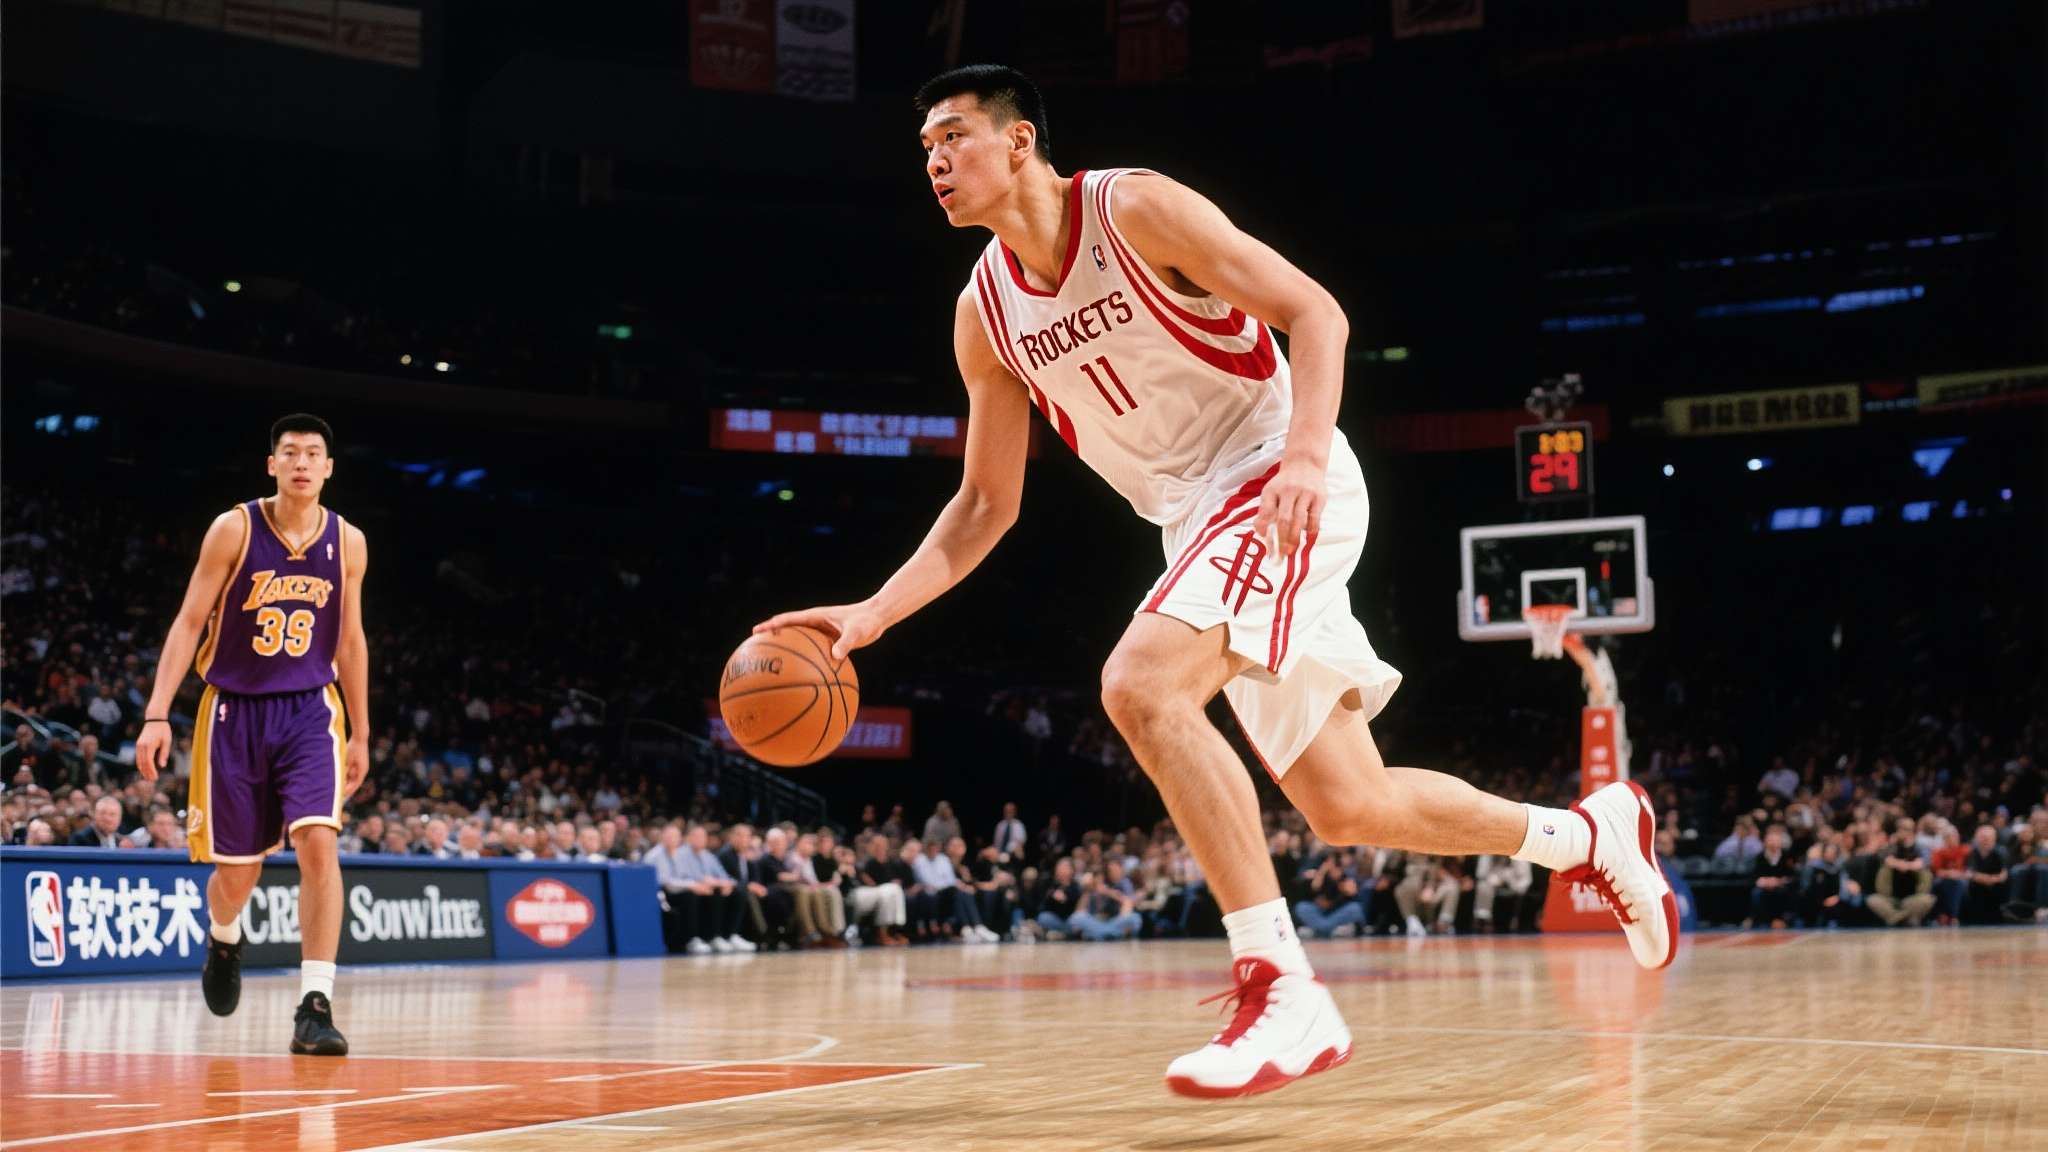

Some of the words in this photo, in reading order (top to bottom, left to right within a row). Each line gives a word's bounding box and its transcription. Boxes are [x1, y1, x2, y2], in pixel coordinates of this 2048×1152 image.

[1016, 291, 1133, 371] ROCKETS
[1079, 355, 1139, 417] 11
[1530, 453, 1578, 494] 29
[242, 570, 334, 612] LAKERS
[66, 876, 205, 960] 软技术
